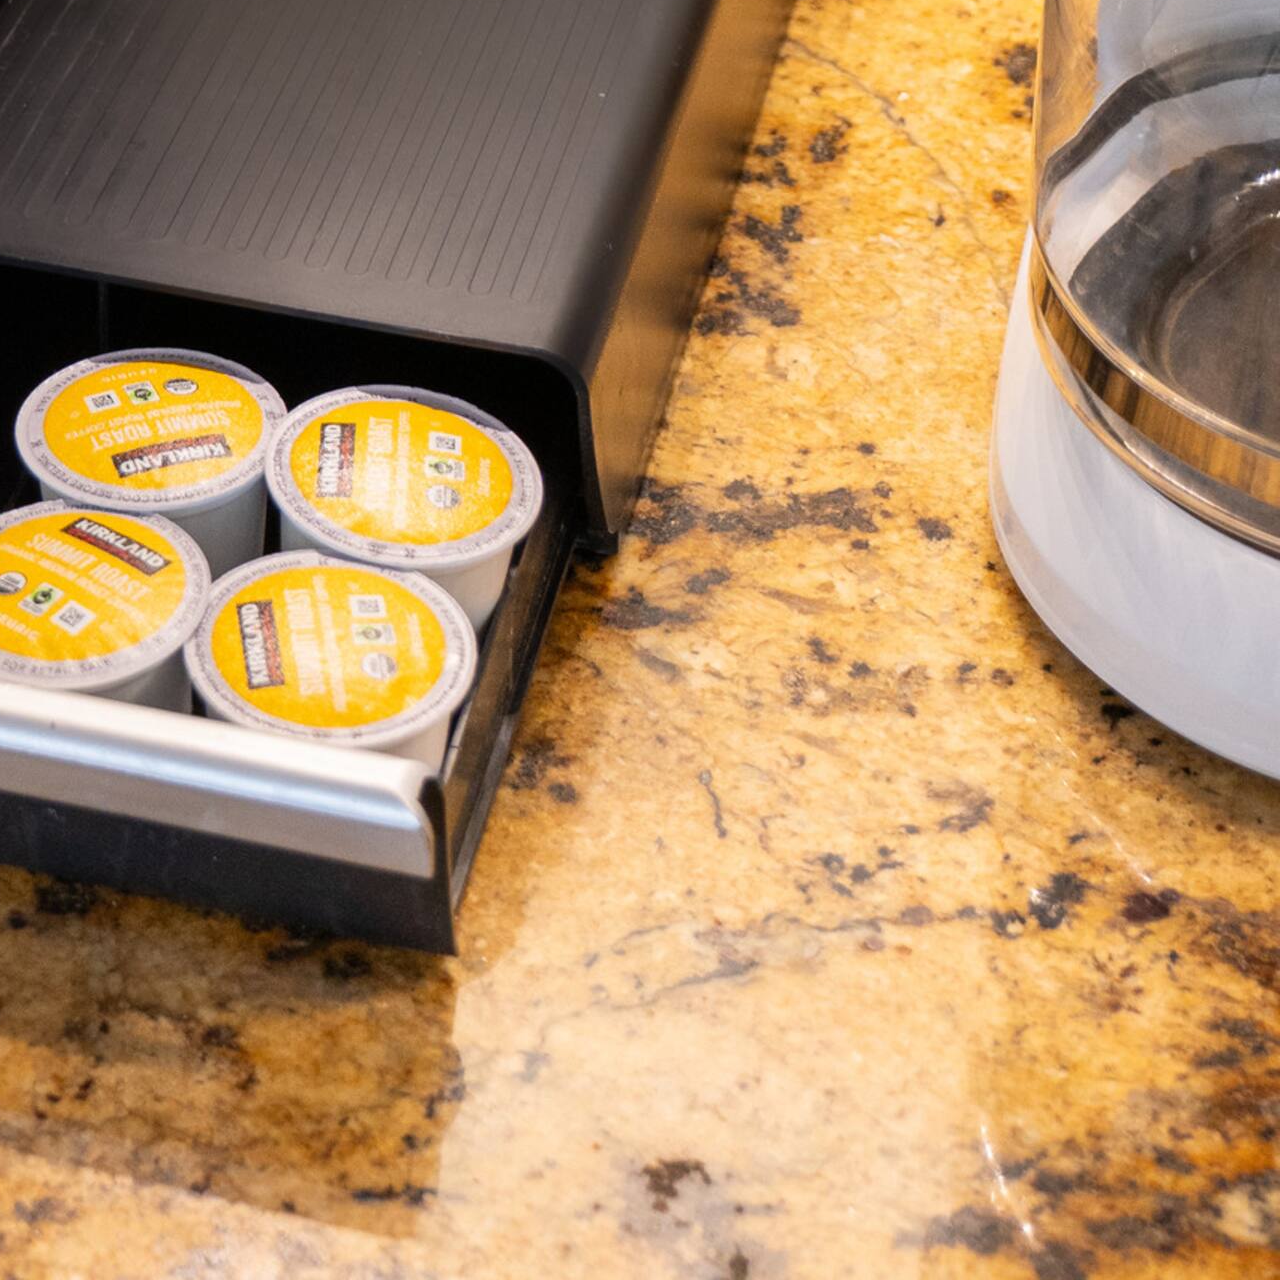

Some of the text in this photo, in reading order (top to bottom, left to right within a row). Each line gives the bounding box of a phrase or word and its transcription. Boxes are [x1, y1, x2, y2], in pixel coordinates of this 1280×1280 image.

[89, 422, 152, 451] ROAST
[154, 408, 228, 435] SUMMIT
[118, 440, 225, 474] KIRKLAND
[74, 517, 167, 568] KIRKLAND
[25, 530, 96, 570] SUMMIT
[89, 561, 150, 601] ROAST
[240, 602, 269, 684] KIRKLAND
